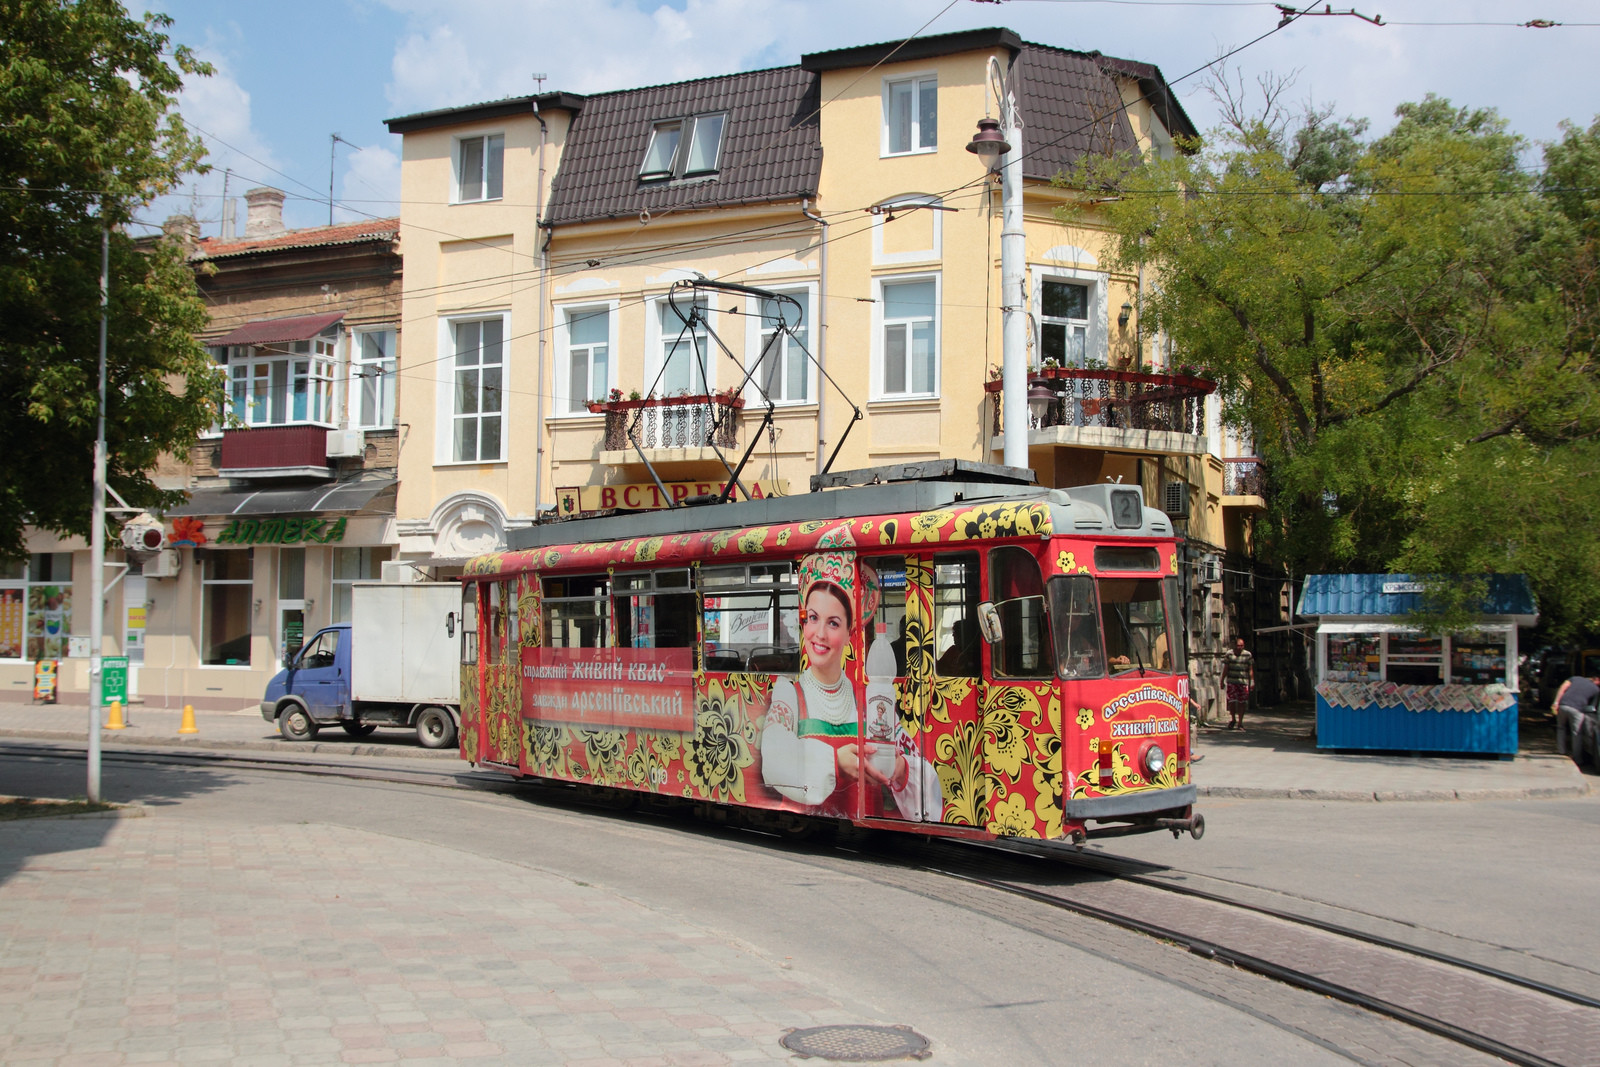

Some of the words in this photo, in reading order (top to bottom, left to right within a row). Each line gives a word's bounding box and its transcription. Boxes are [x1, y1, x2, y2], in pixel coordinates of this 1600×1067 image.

[1121, 497, 1131, 518] 2
[216, 517, 347, 544] АПТЕКА
[731, 611, 769, 634] Bonjour
